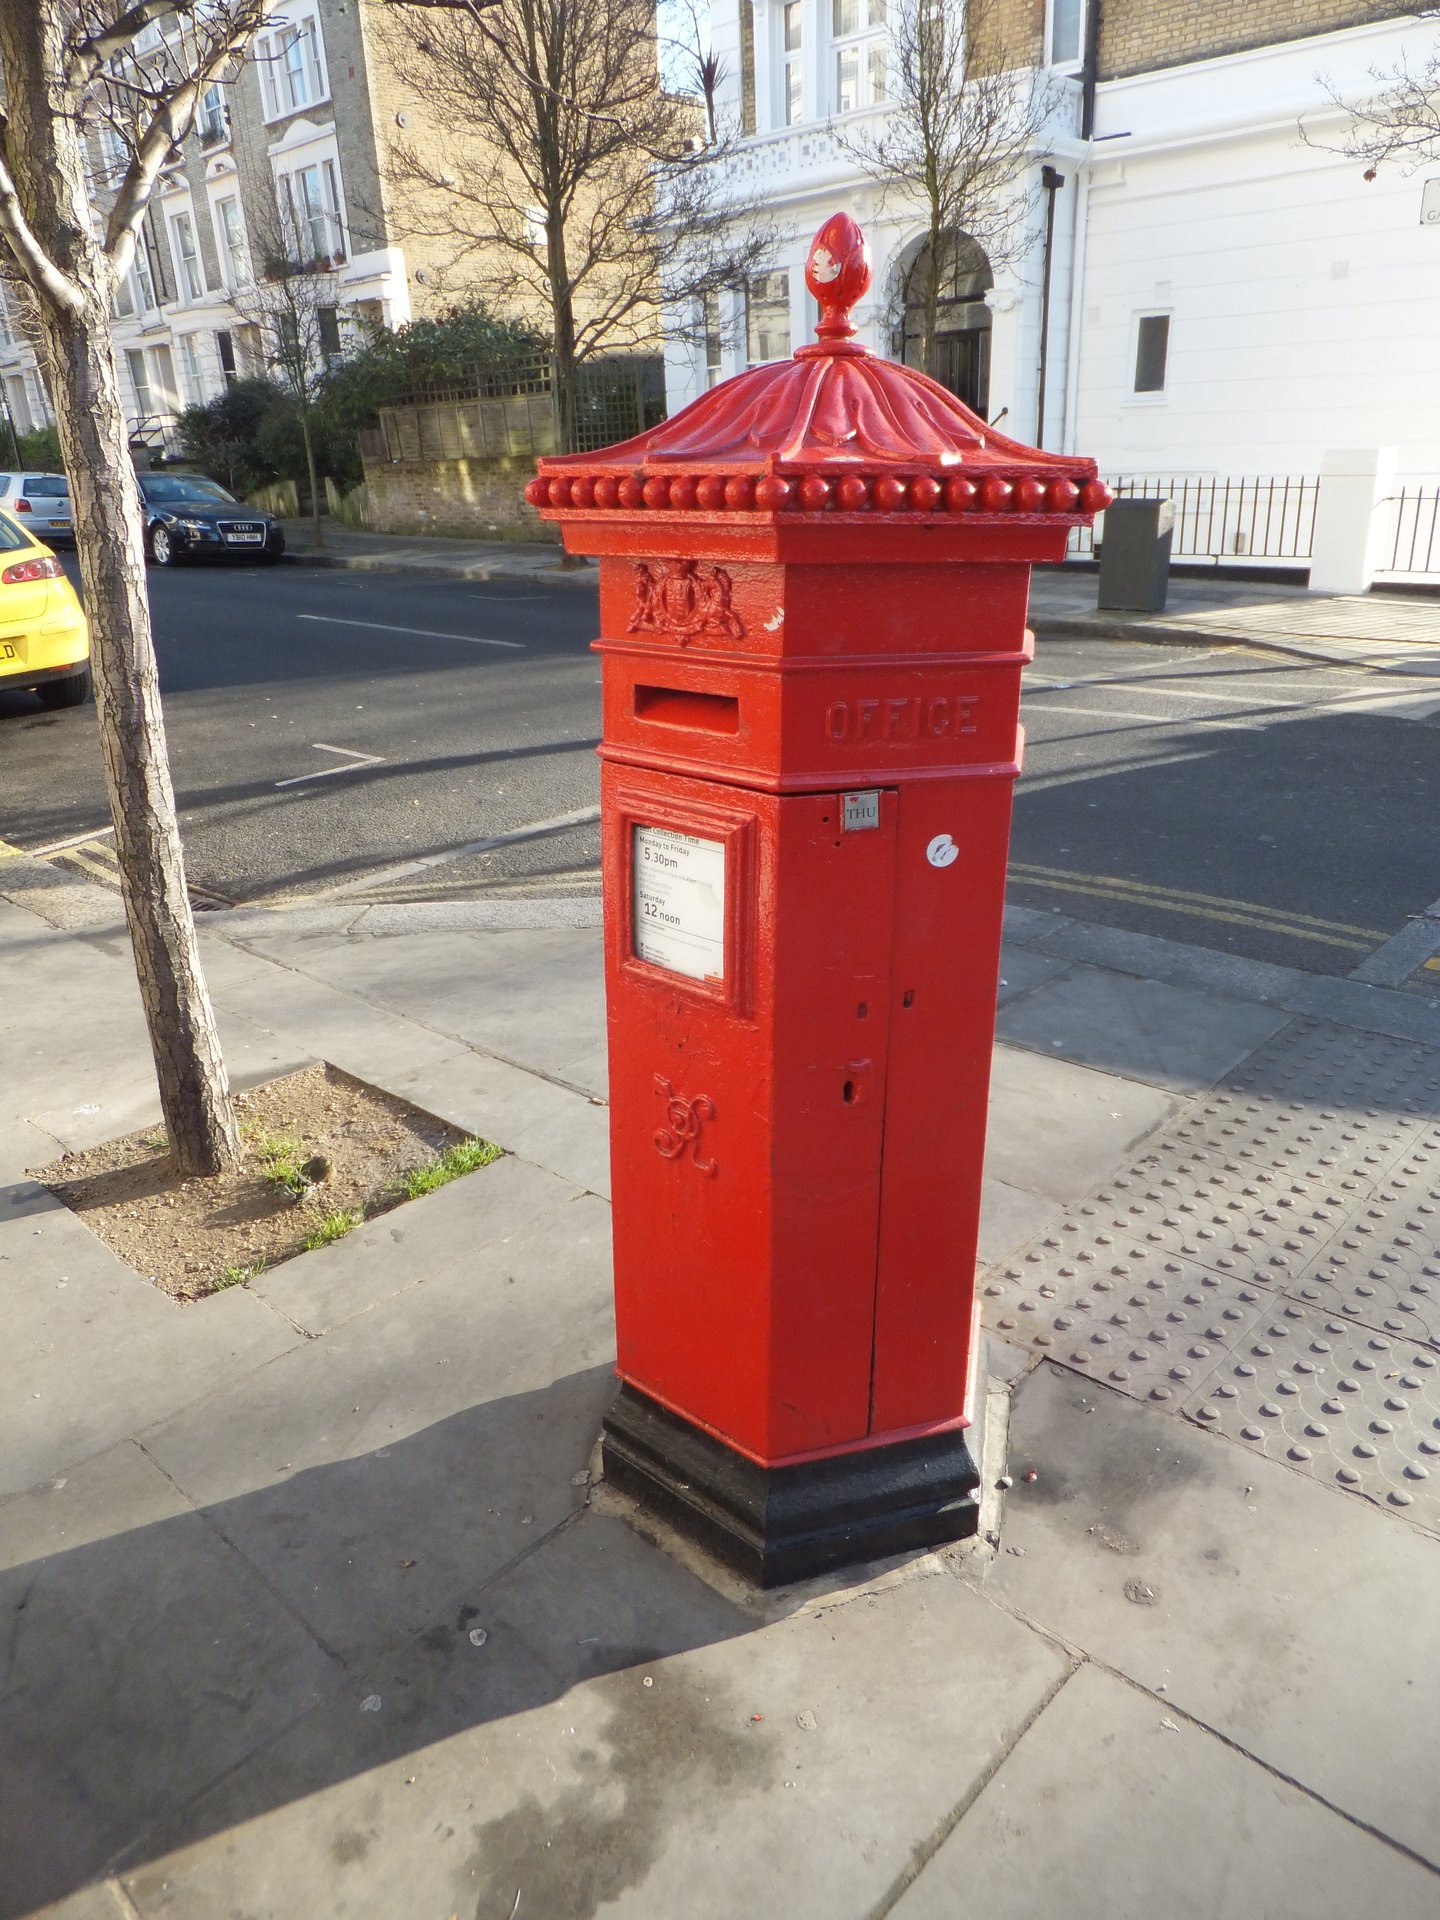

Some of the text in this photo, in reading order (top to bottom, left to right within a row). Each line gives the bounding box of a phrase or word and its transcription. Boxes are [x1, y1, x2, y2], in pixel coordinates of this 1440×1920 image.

[824, 695, 979, 740] OFFICE
[846, 806, 877, 820] THU
[639, 835, 662, 849] Monday
[670, 844, 690, 857] Friday
[653, 828, 683, 841] Collection
[684, 834, 700, 845] Time
[644, 847, 678, 868] 5.30pm
[639, 891, 666, 906] Saturday
[644, 902, 658, 918] 12
[659, 912, 681, 925] noon
